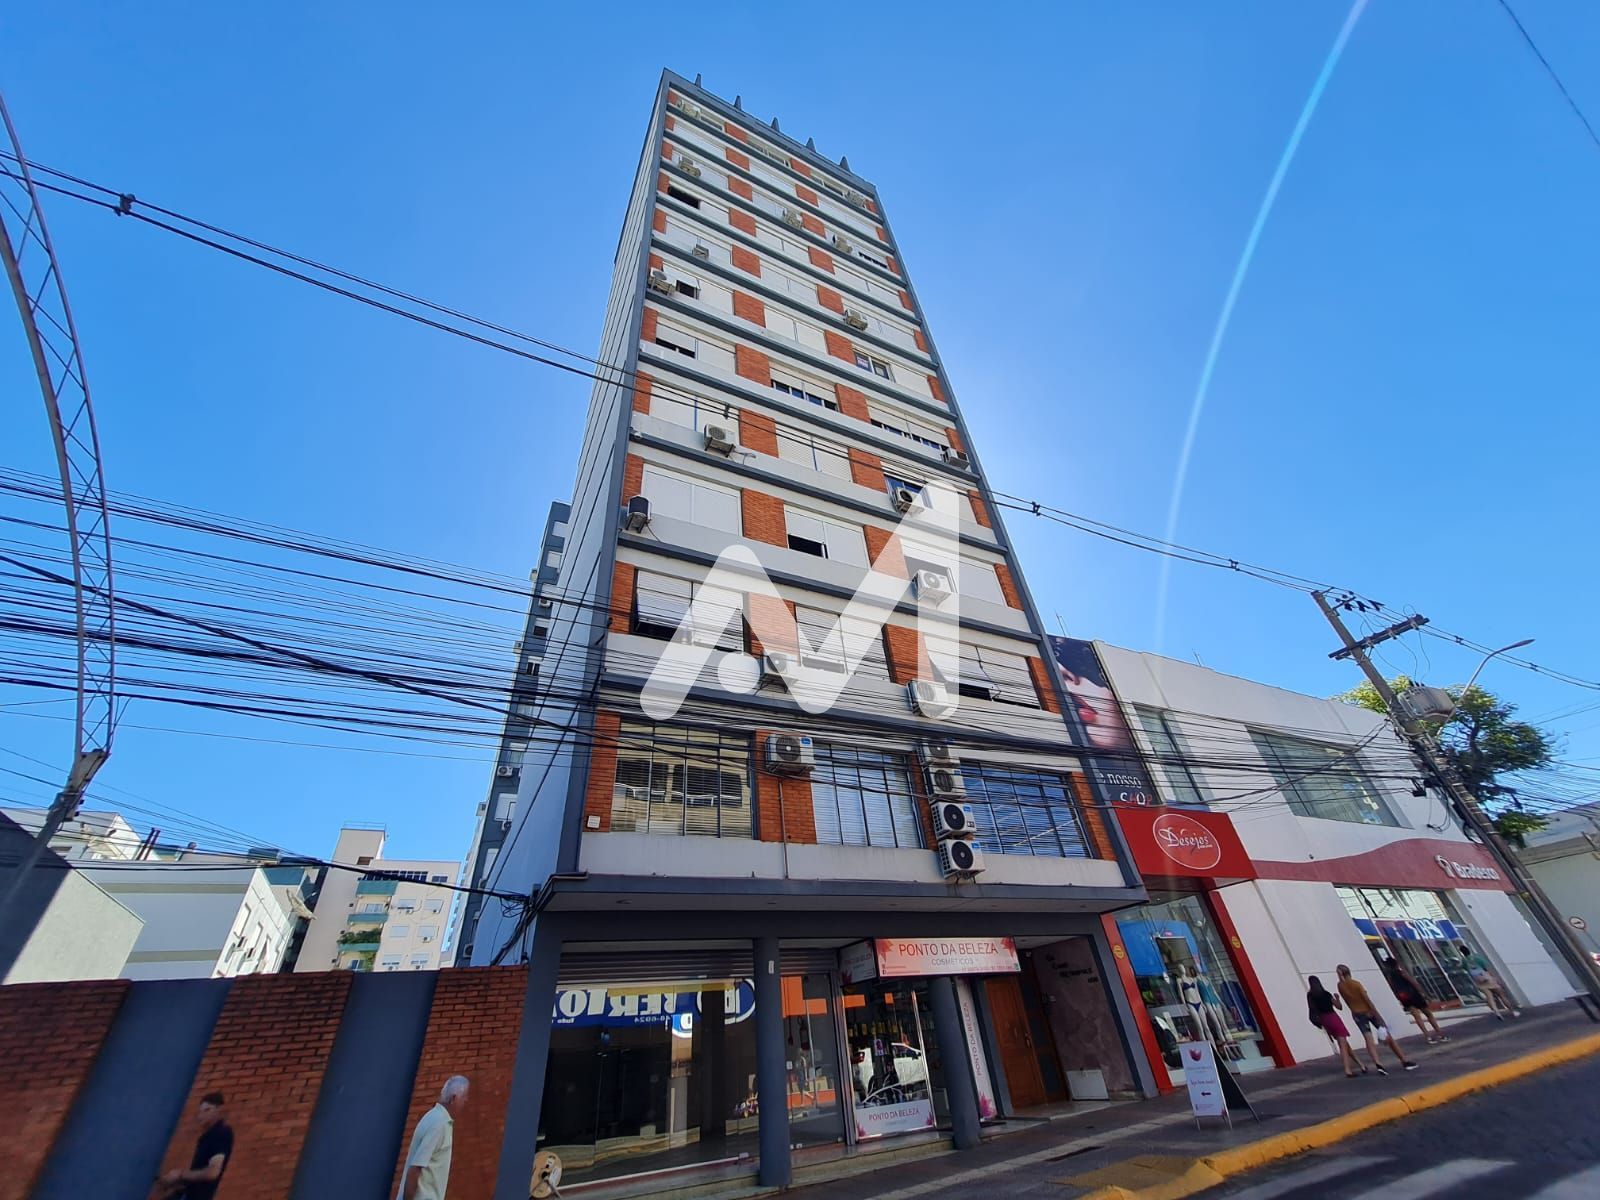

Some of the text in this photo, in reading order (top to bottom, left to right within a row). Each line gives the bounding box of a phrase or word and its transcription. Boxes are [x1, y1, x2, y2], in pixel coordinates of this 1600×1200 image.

[1107, 773, 1142, 789] nosso
[1158, 827, 1209, 850] Desejos
[898, 942, 1000, 957] PONTO DA BELEZA
[868, 1107, 920, 1121] PONTO DA BELEZA
